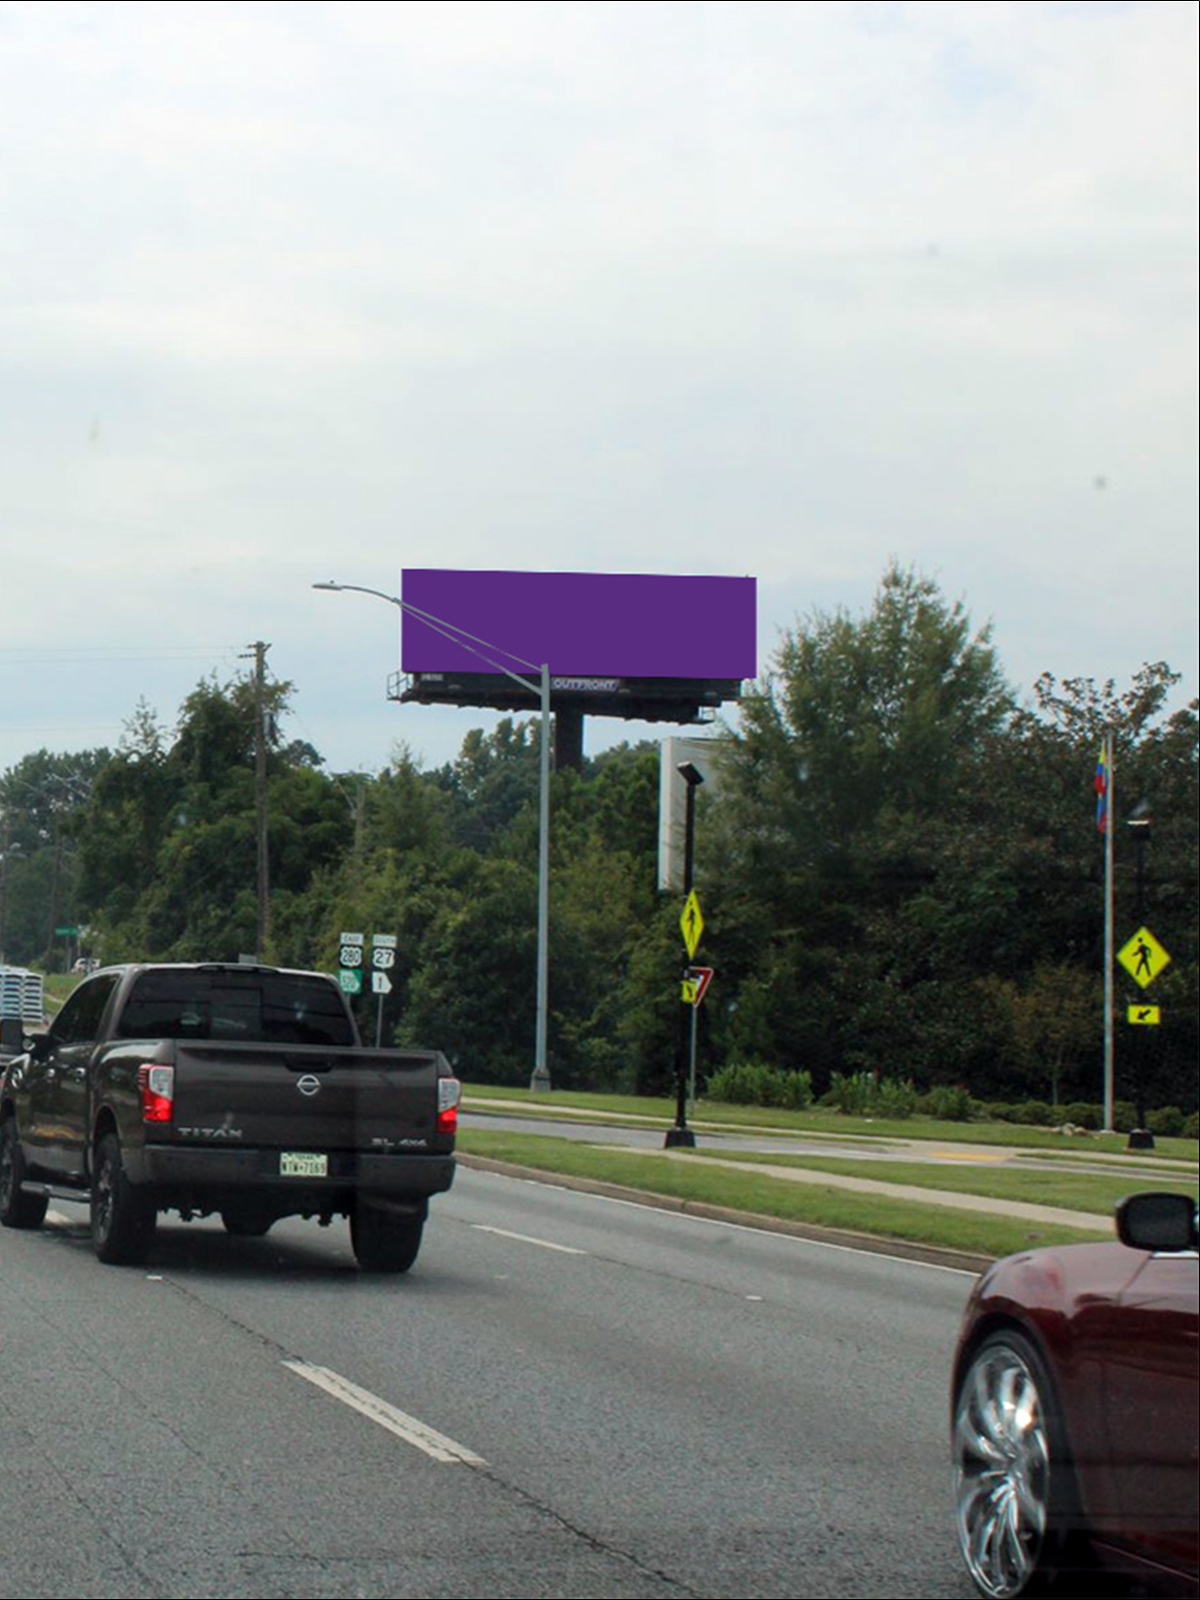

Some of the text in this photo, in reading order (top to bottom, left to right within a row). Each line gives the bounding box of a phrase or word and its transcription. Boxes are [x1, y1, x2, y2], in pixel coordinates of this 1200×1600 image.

[552, 678, 618, 691] OUTFRONT
[375, 950, 393, 964] 27
[178, 1127, 242, 1138] TITAN
